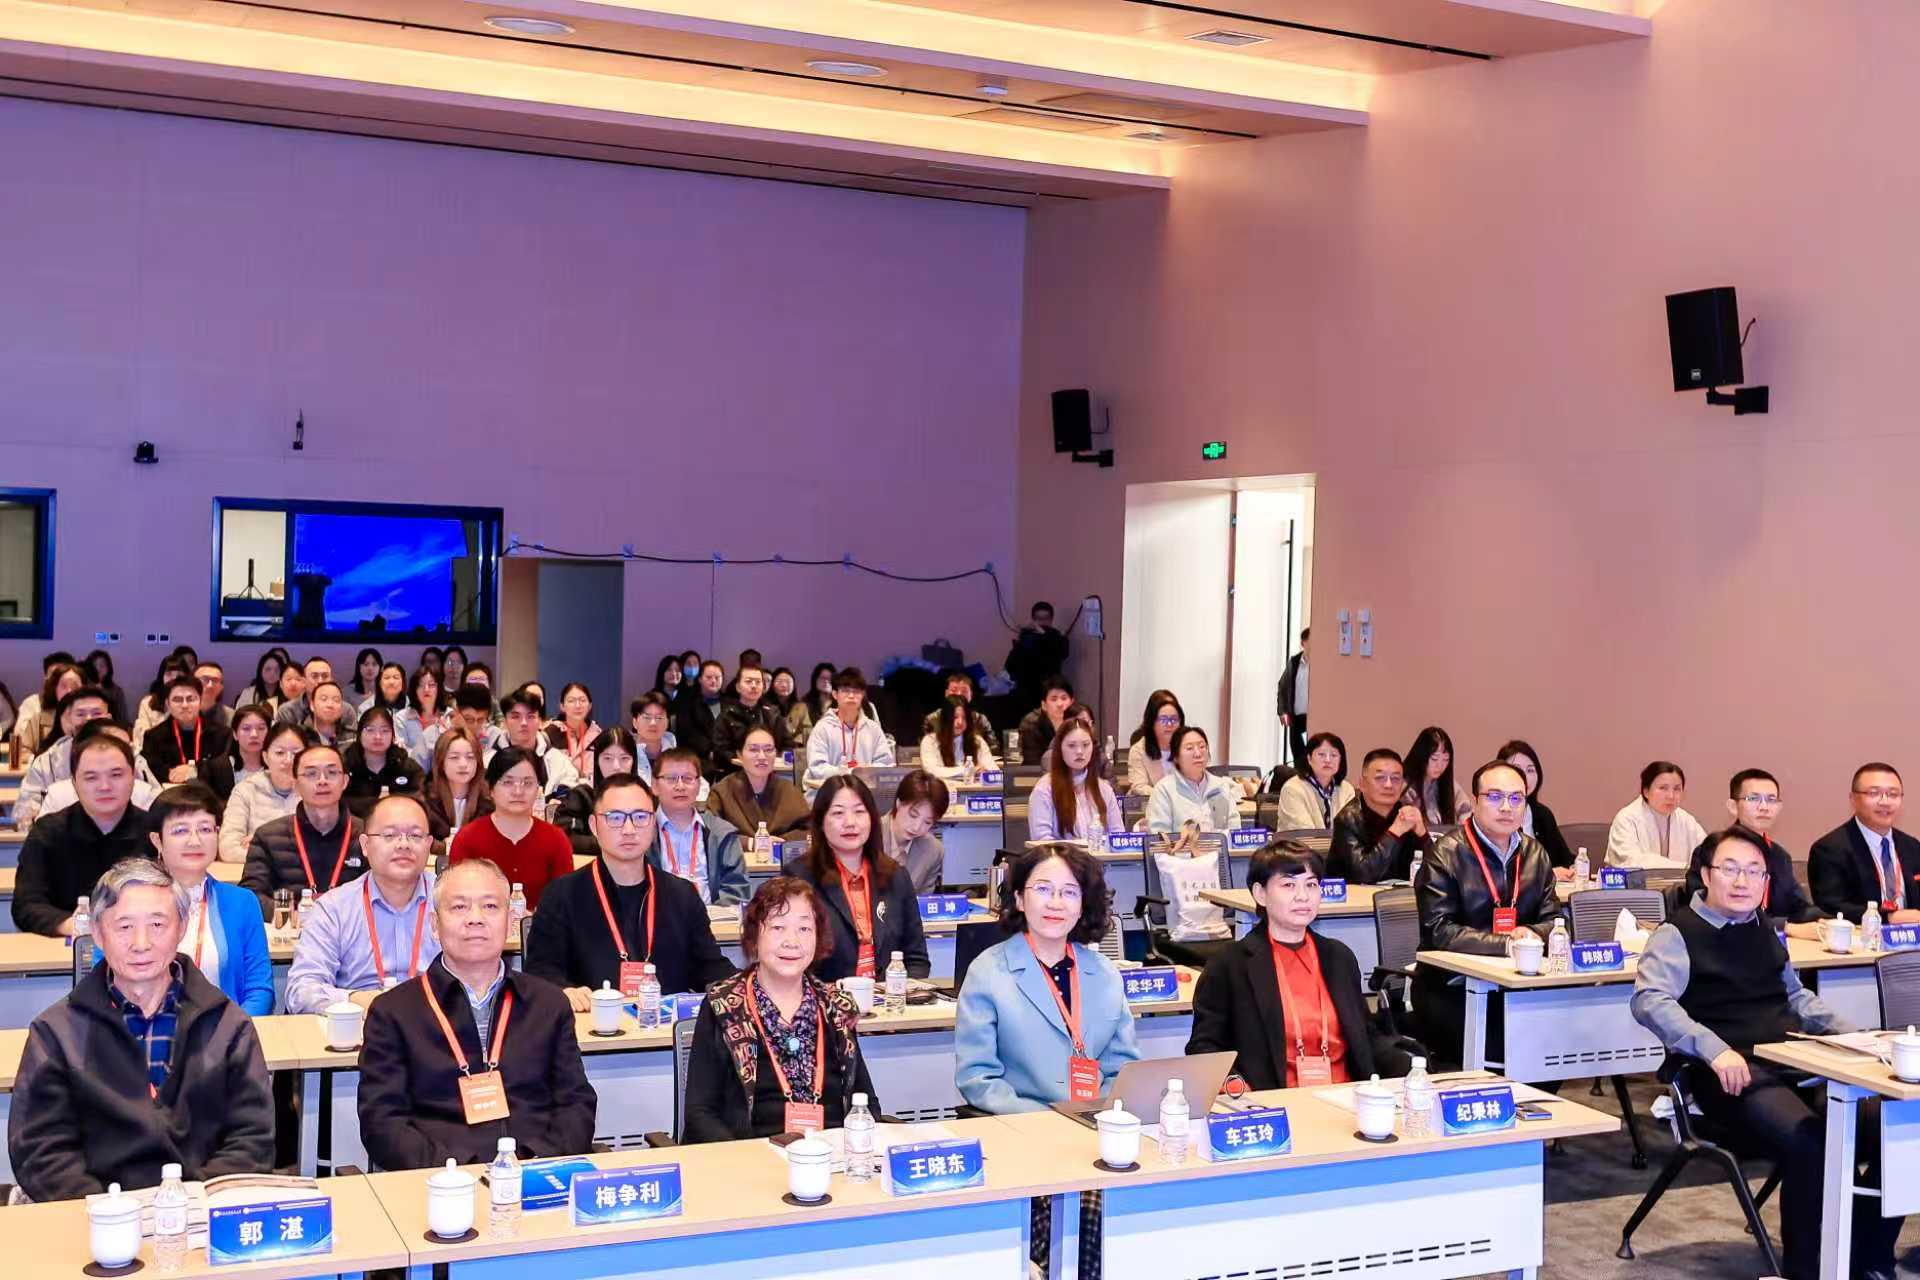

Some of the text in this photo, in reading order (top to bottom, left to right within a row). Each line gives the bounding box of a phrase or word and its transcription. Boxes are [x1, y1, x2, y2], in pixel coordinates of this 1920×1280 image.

[1234, 833, 1265, 844] 媒体代表
[1126, 977, 1166, 994] 梁华平
[1225, 1123, 1274, 1147] 车玉玲
[908, 1153, 966, 1179] 王晓东
[595, 1180, 660, 1209] 梅争利
